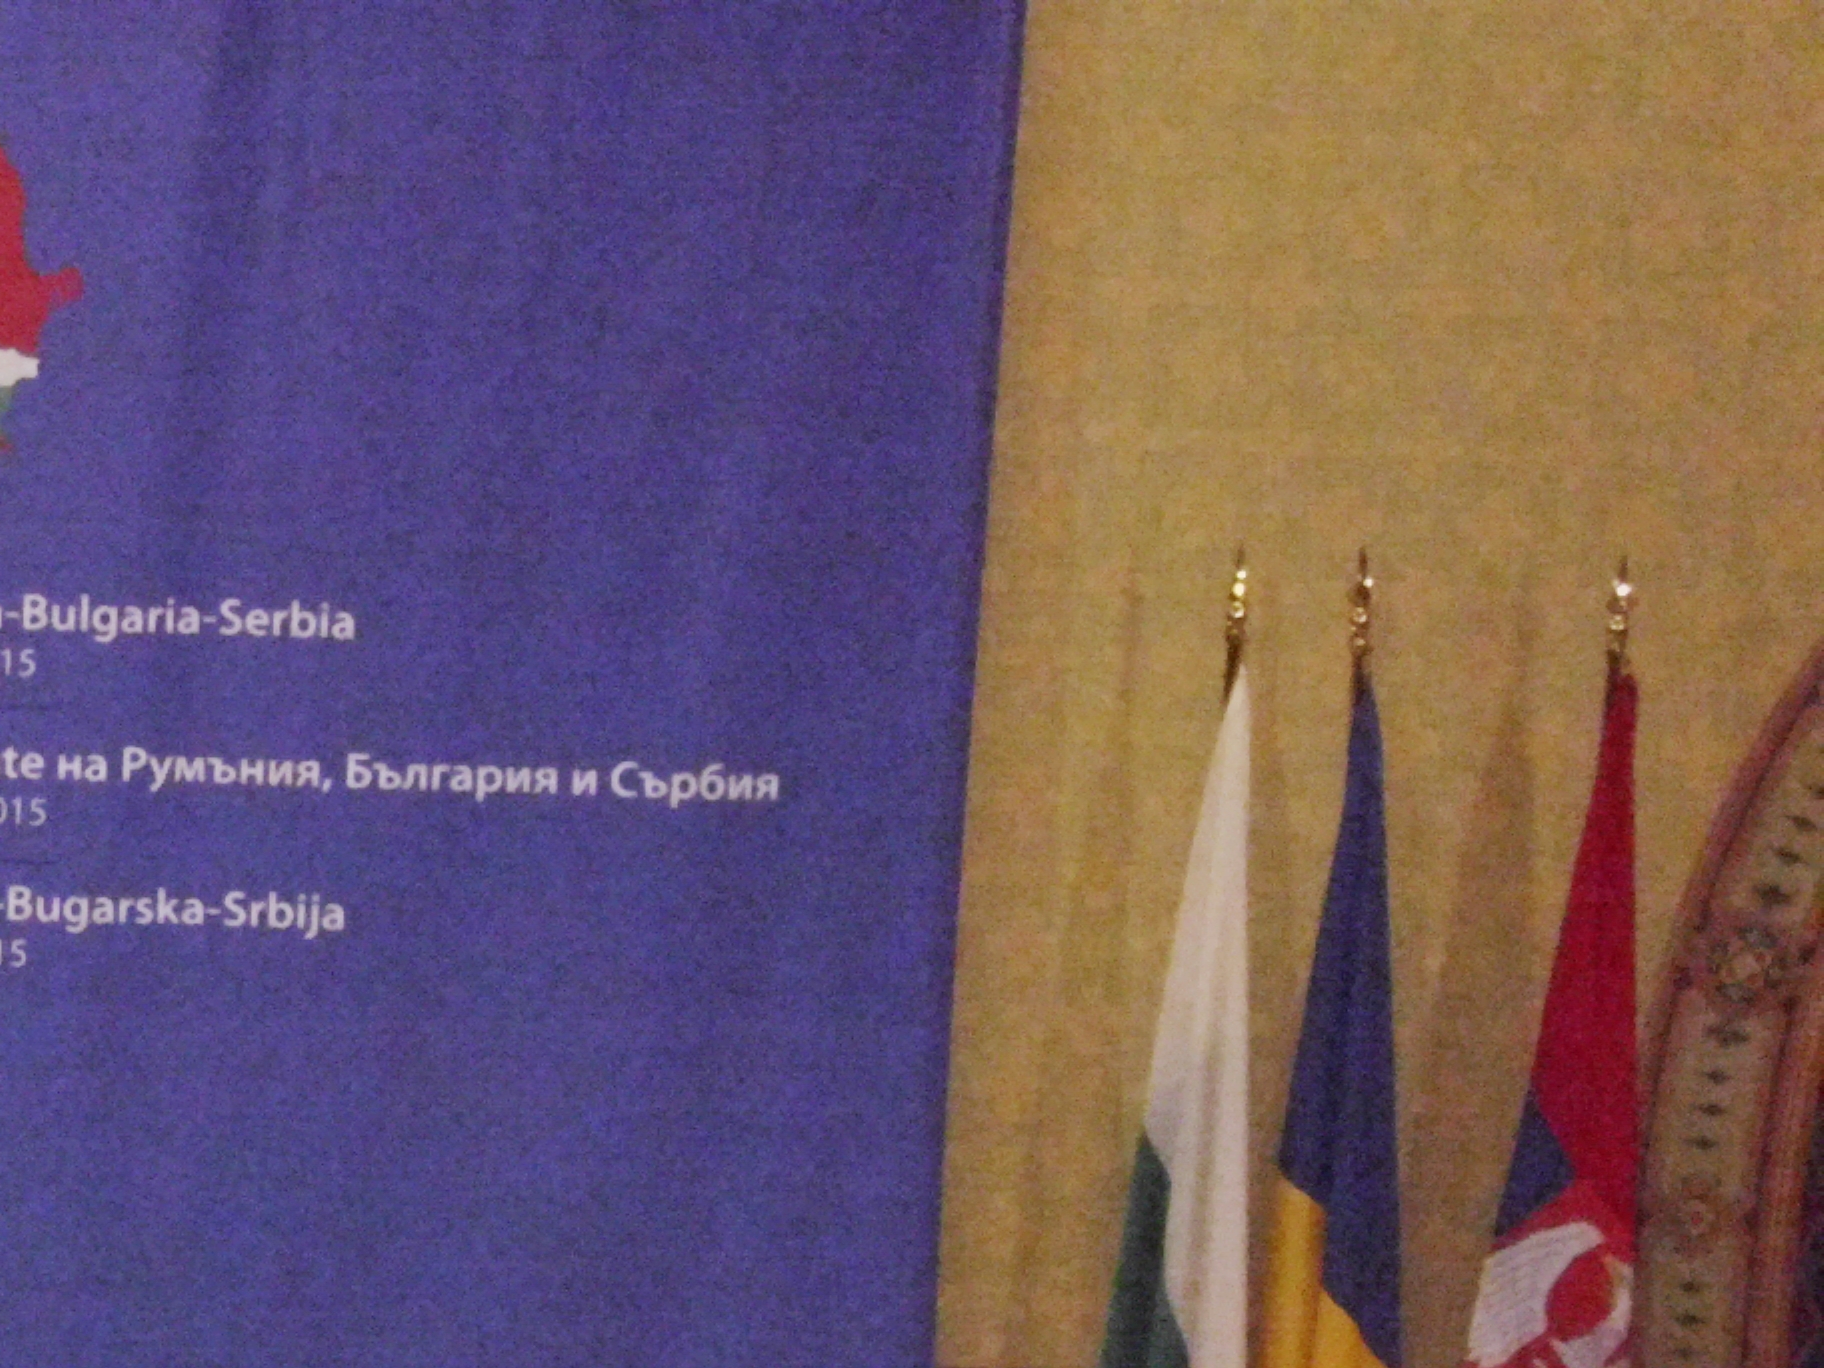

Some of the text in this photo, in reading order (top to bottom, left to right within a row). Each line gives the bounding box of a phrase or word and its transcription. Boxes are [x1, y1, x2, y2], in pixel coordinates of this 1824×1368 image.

[57, 753, 108, 783] на
[346, 753, 558, 801] България
[570, 769, 598, 796] и
[610, 761, 779, 808] Сърбия
